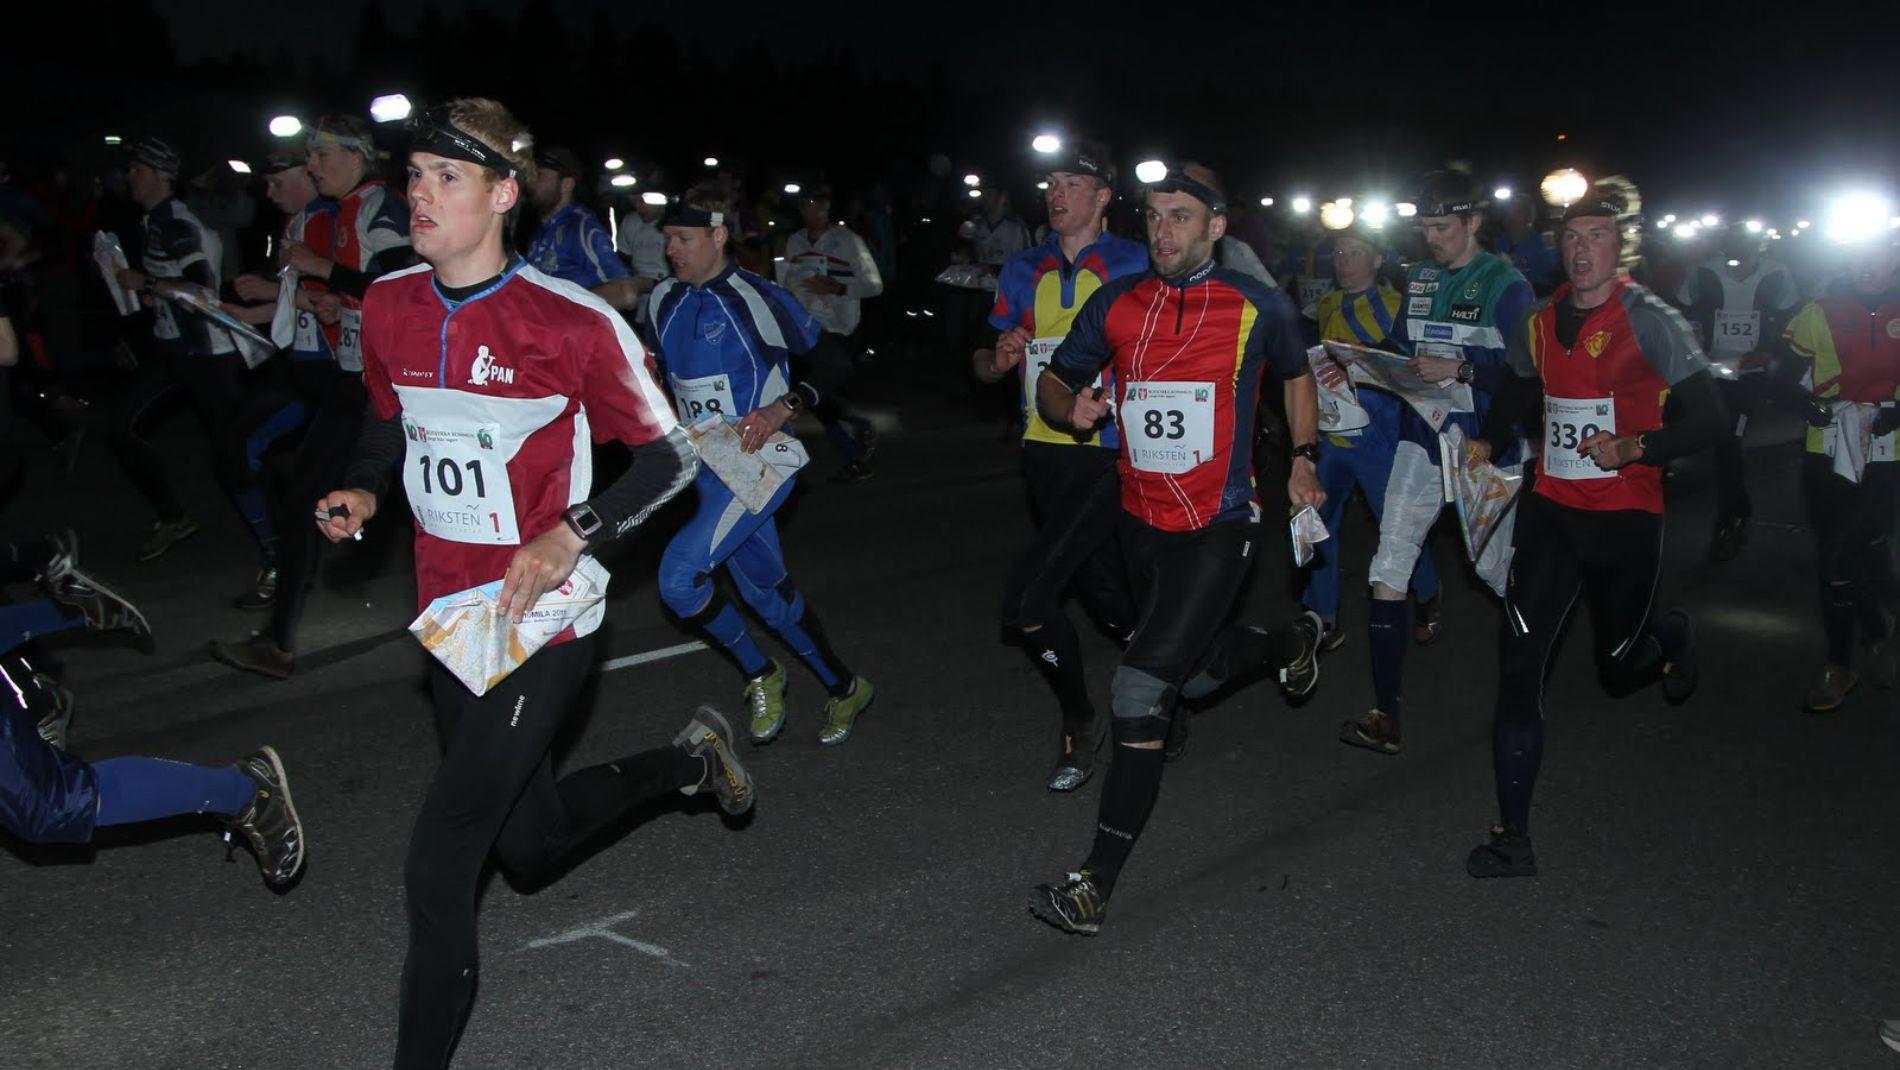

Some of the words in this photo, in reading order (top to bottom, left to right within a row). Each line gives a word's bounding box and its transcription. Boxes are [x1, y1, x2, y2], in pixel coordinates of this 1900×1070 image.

[1451, 307, 1480, 320] HALTI
[1721, 322, 1753, 336] 152
[490, 365, 514, 384] PAN
[1144, 409, 1185, 440] 83
[1192, 449, 1201, 465] 1
[420, 454, 486, 499] 101
[488, 511, 500, 534] 1
[510, 694, 526, 727] newline
